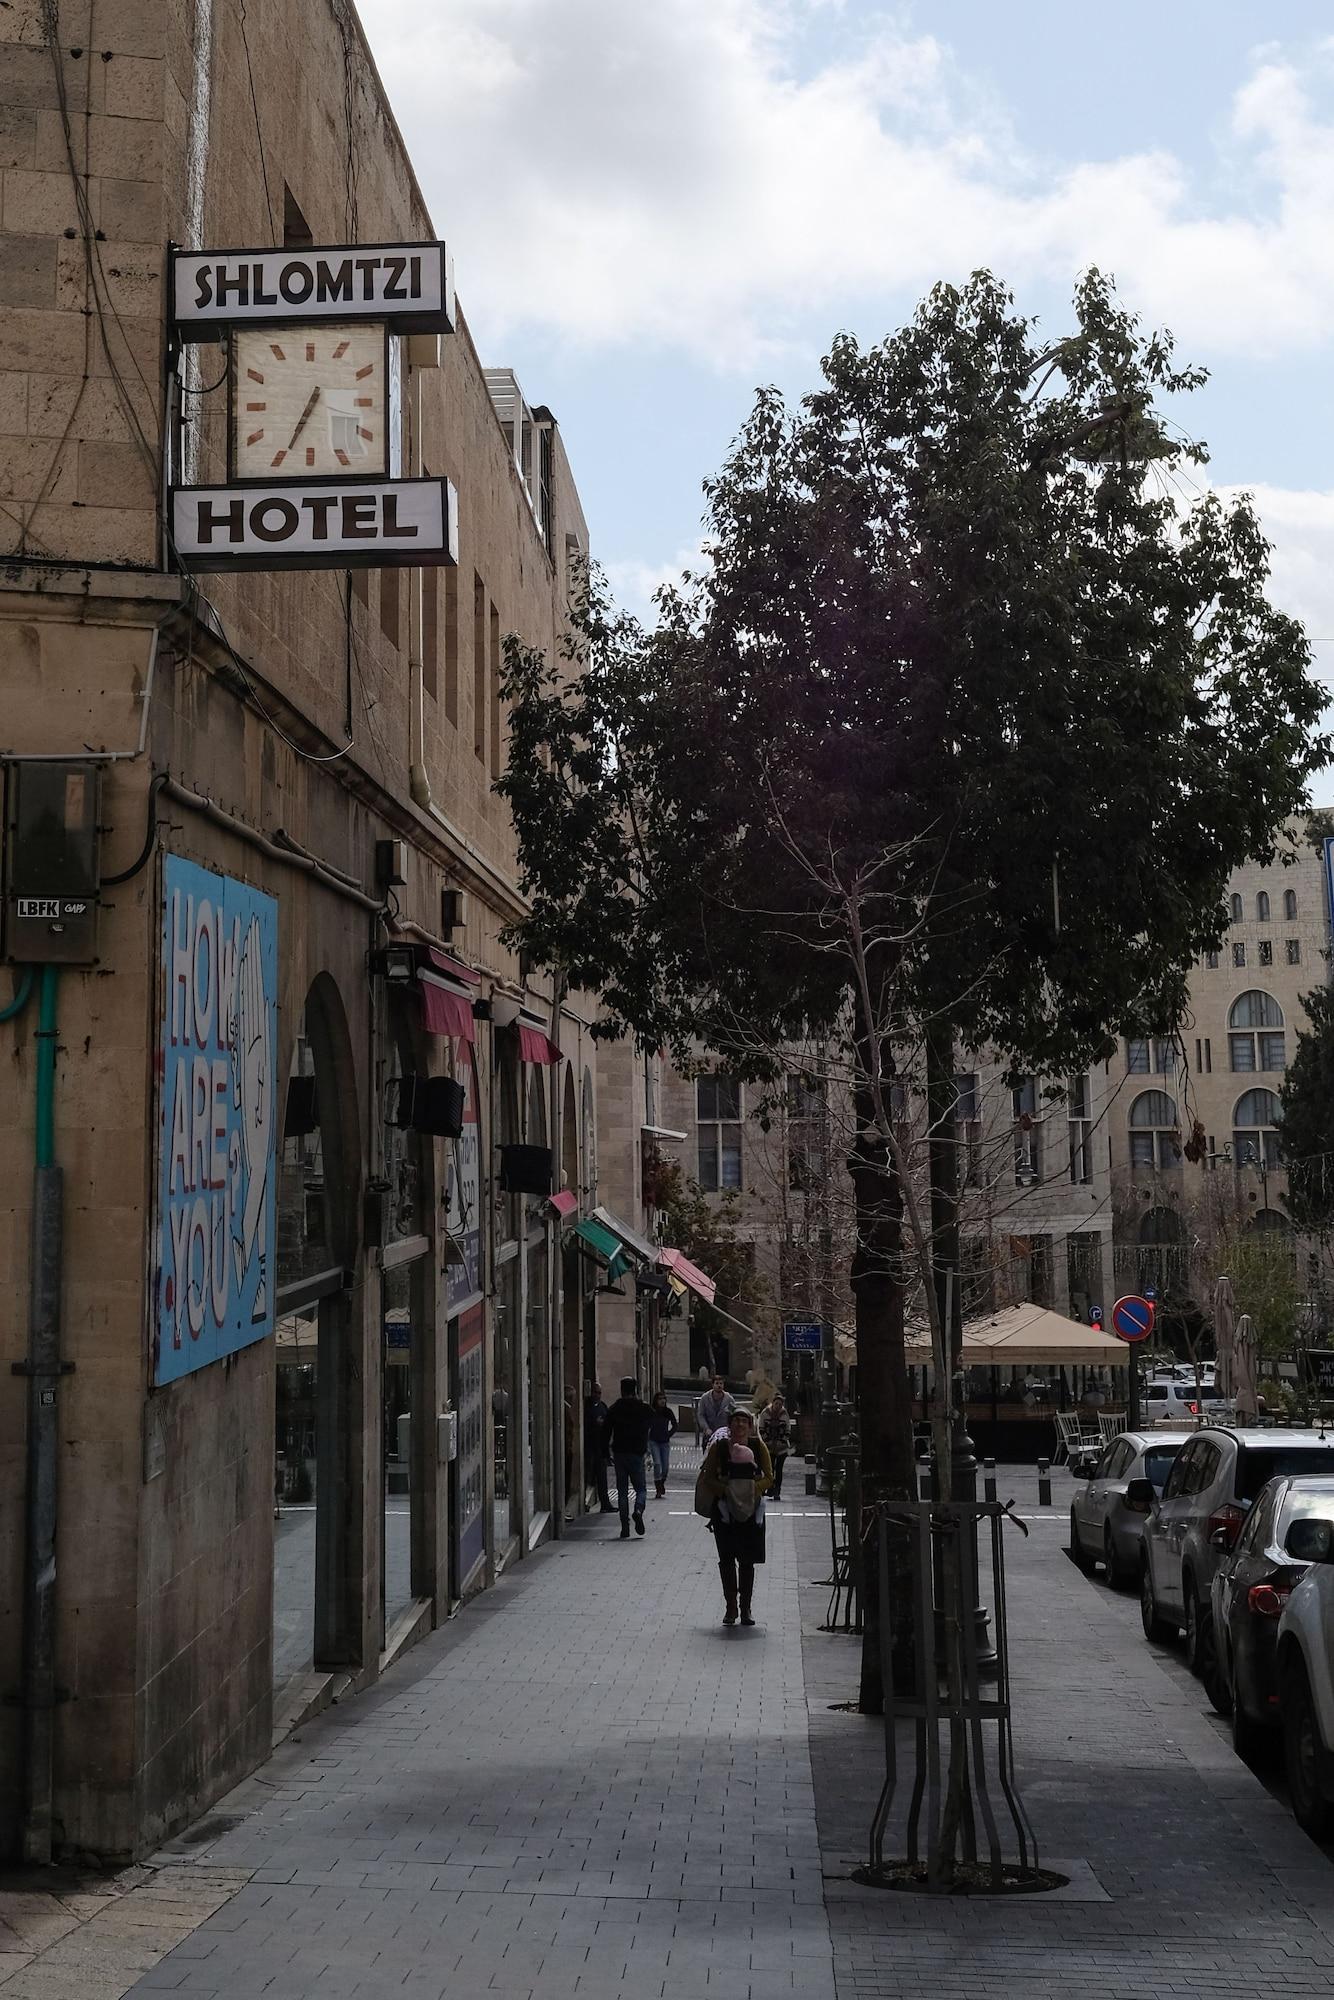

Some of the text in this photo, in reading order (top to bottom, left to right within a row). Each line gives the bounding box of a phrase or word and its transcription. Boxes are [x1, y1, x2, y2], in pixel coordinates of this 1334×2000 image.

[195, 256, 422, 310] SHLOMTZI
[197, 494, 418, 544] HOTEL
[19, 901, 58, 916] LBFK
[171, 888, 241, 1050] HOW
[169, 1056, 228, 1196] ARE
